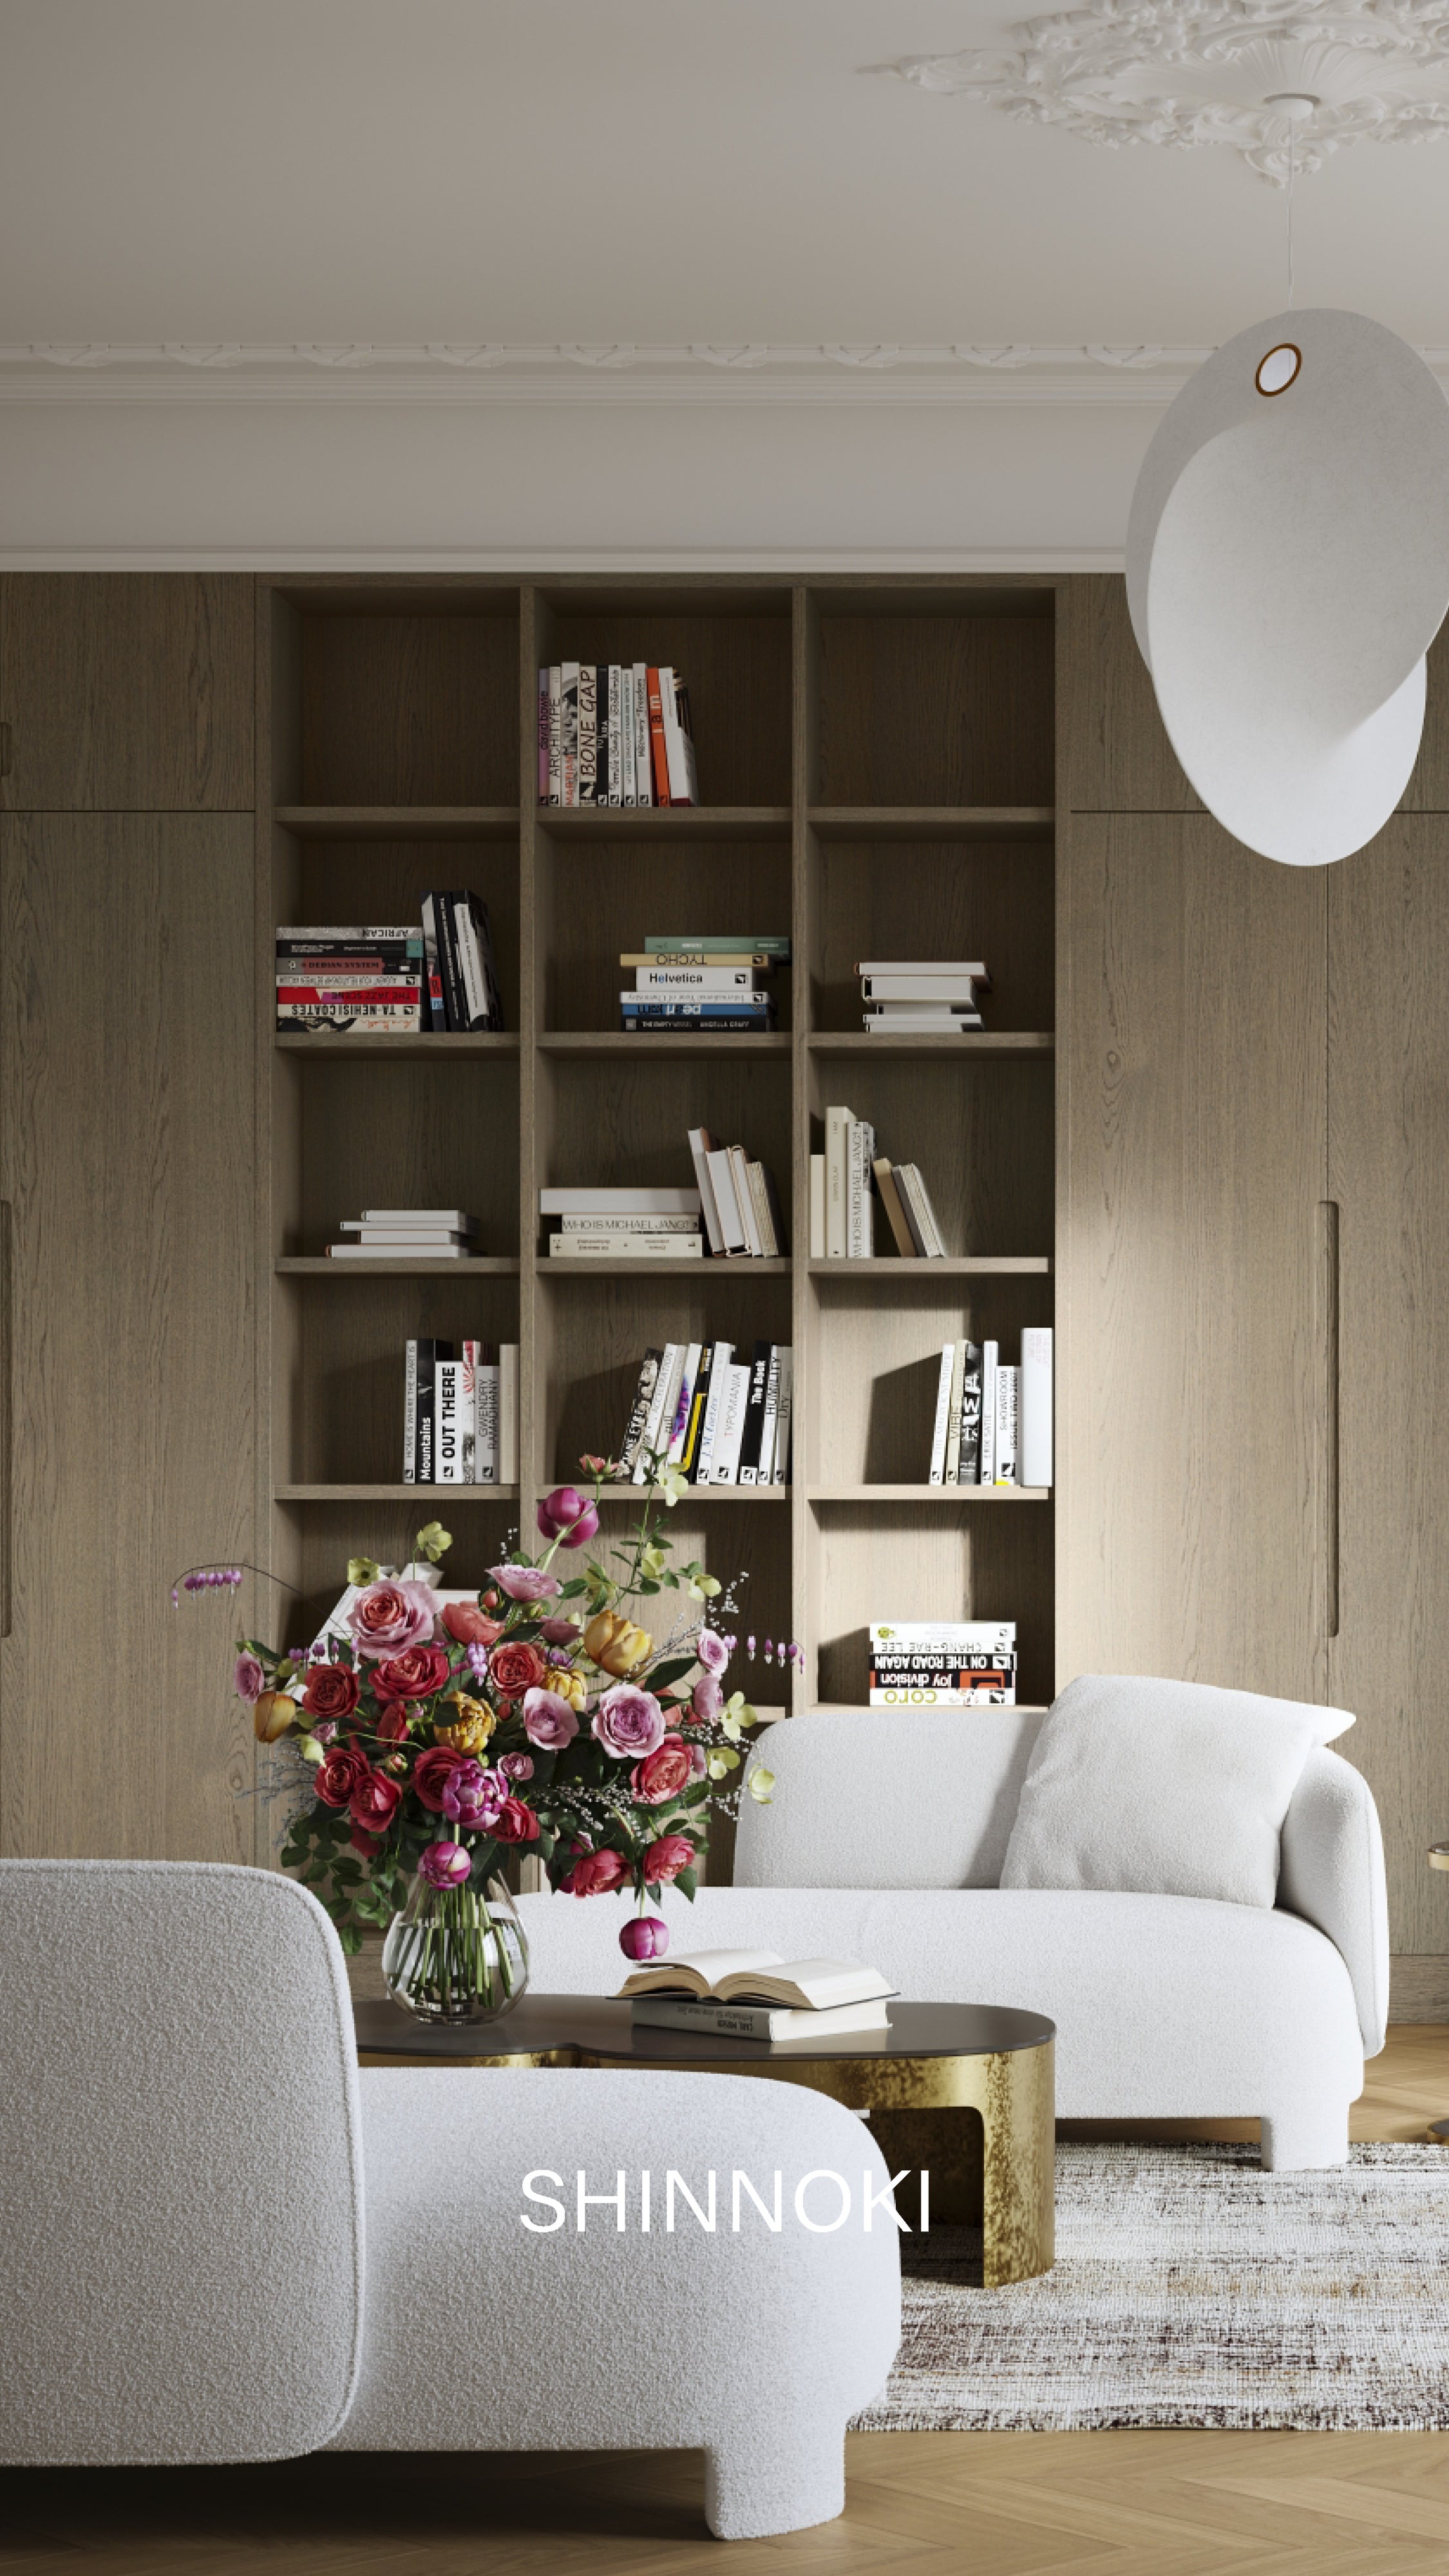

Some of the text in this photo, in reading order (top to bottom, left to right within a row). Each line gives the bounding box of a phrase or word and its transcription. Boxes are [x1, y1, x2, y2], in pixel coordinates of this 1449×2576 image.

[580, 670, 596, 776] BONE GAP
[363, 929, 408, 938] AFRICAN
[656, 954, 707, 965] TYCHO
[649, 972, 703, 983] Helvetica
[332, 991, 361, 999] SCENE
[291, 1005, 336, 1015] COATES
[853, 1167, 862, 1215] MICHAEL
[607, 1220, 654, 1229] MICHAEL
[724, 1372, 741, 1437] TYPOMANIA
[442, 1367, 455, 1458] OUT THERE
[420, 1417, 431, 1480] Mountains
[881, 1642, 981, 1652] CHANG-RAE LEE
[875, 1656, 988, 1669] ON THE ROAD AGAIN
[881, 1674, 930, 1687] division
